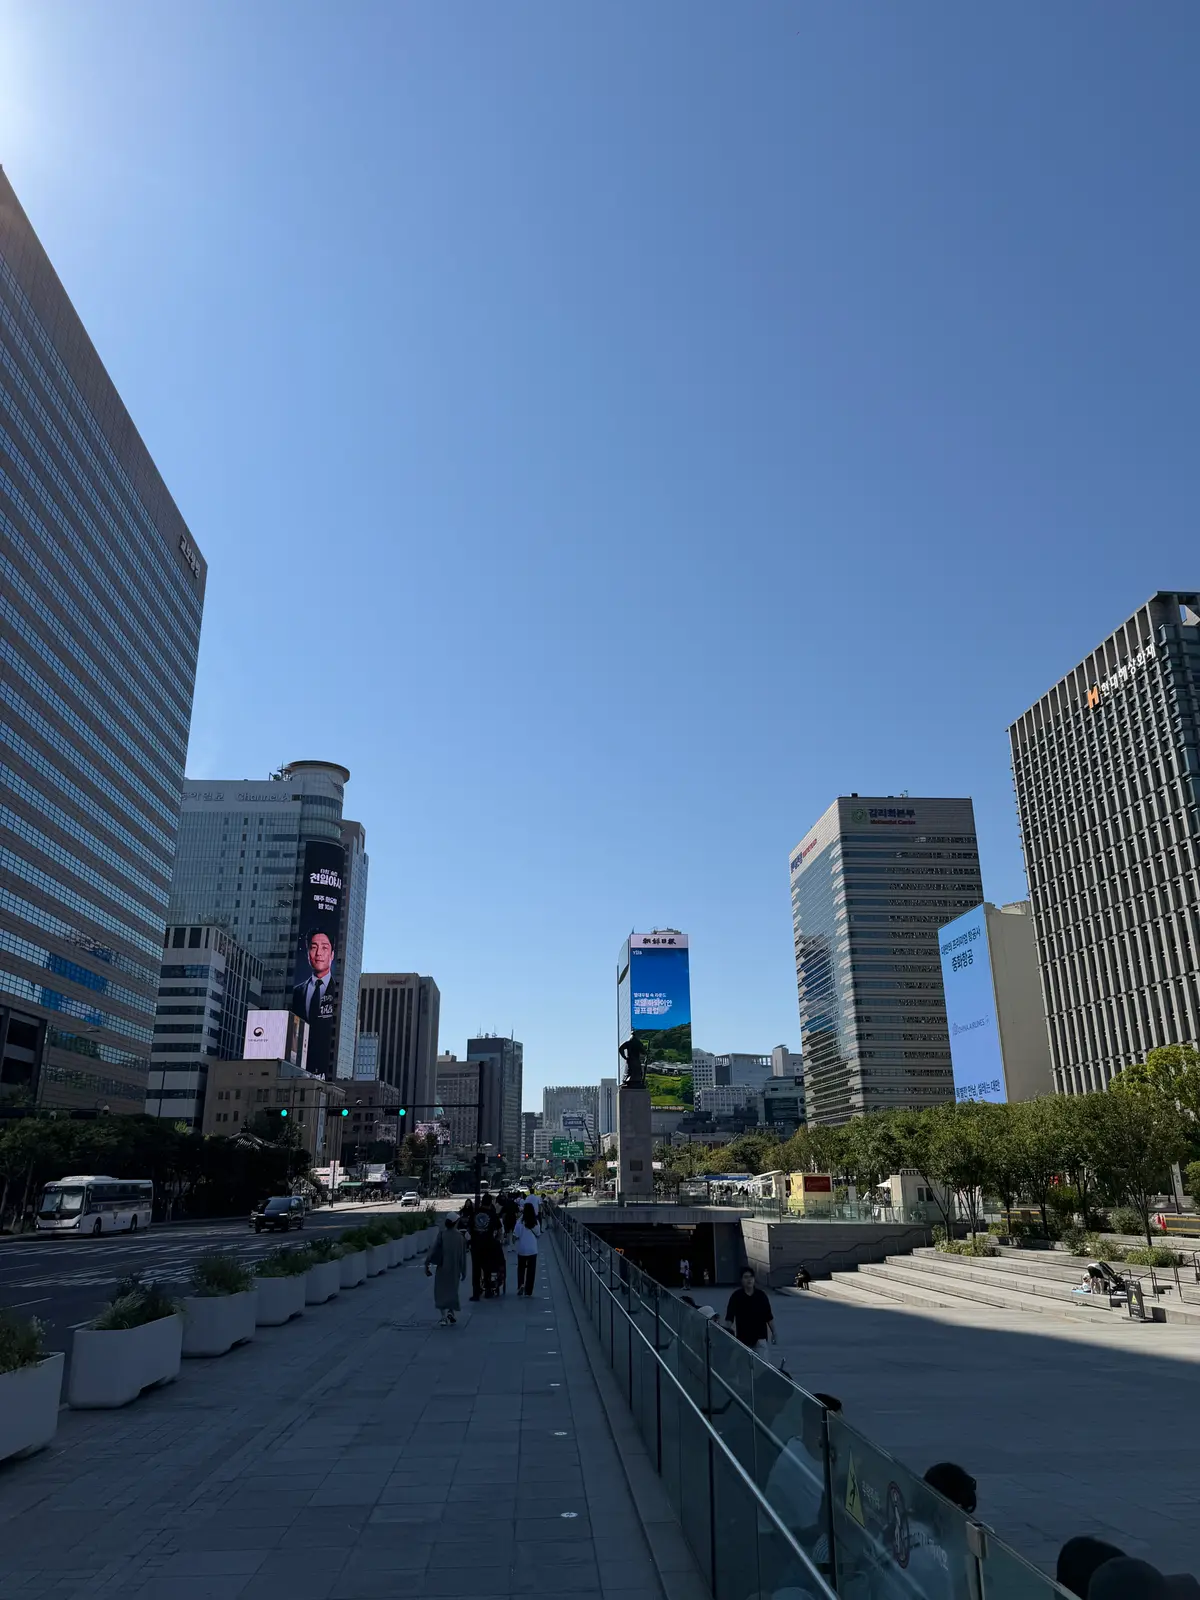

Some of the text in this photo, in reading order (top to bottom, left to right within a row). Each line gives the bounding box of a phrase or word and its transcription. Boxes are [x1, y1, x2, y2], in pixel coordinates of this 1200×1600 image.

[236, 791, 281, 802] Channel
[869, 808, 916, 818] 감리회본부
[310, 872, 342, 889] 천일야사
[952, 949, 974, 973] 중화항공
